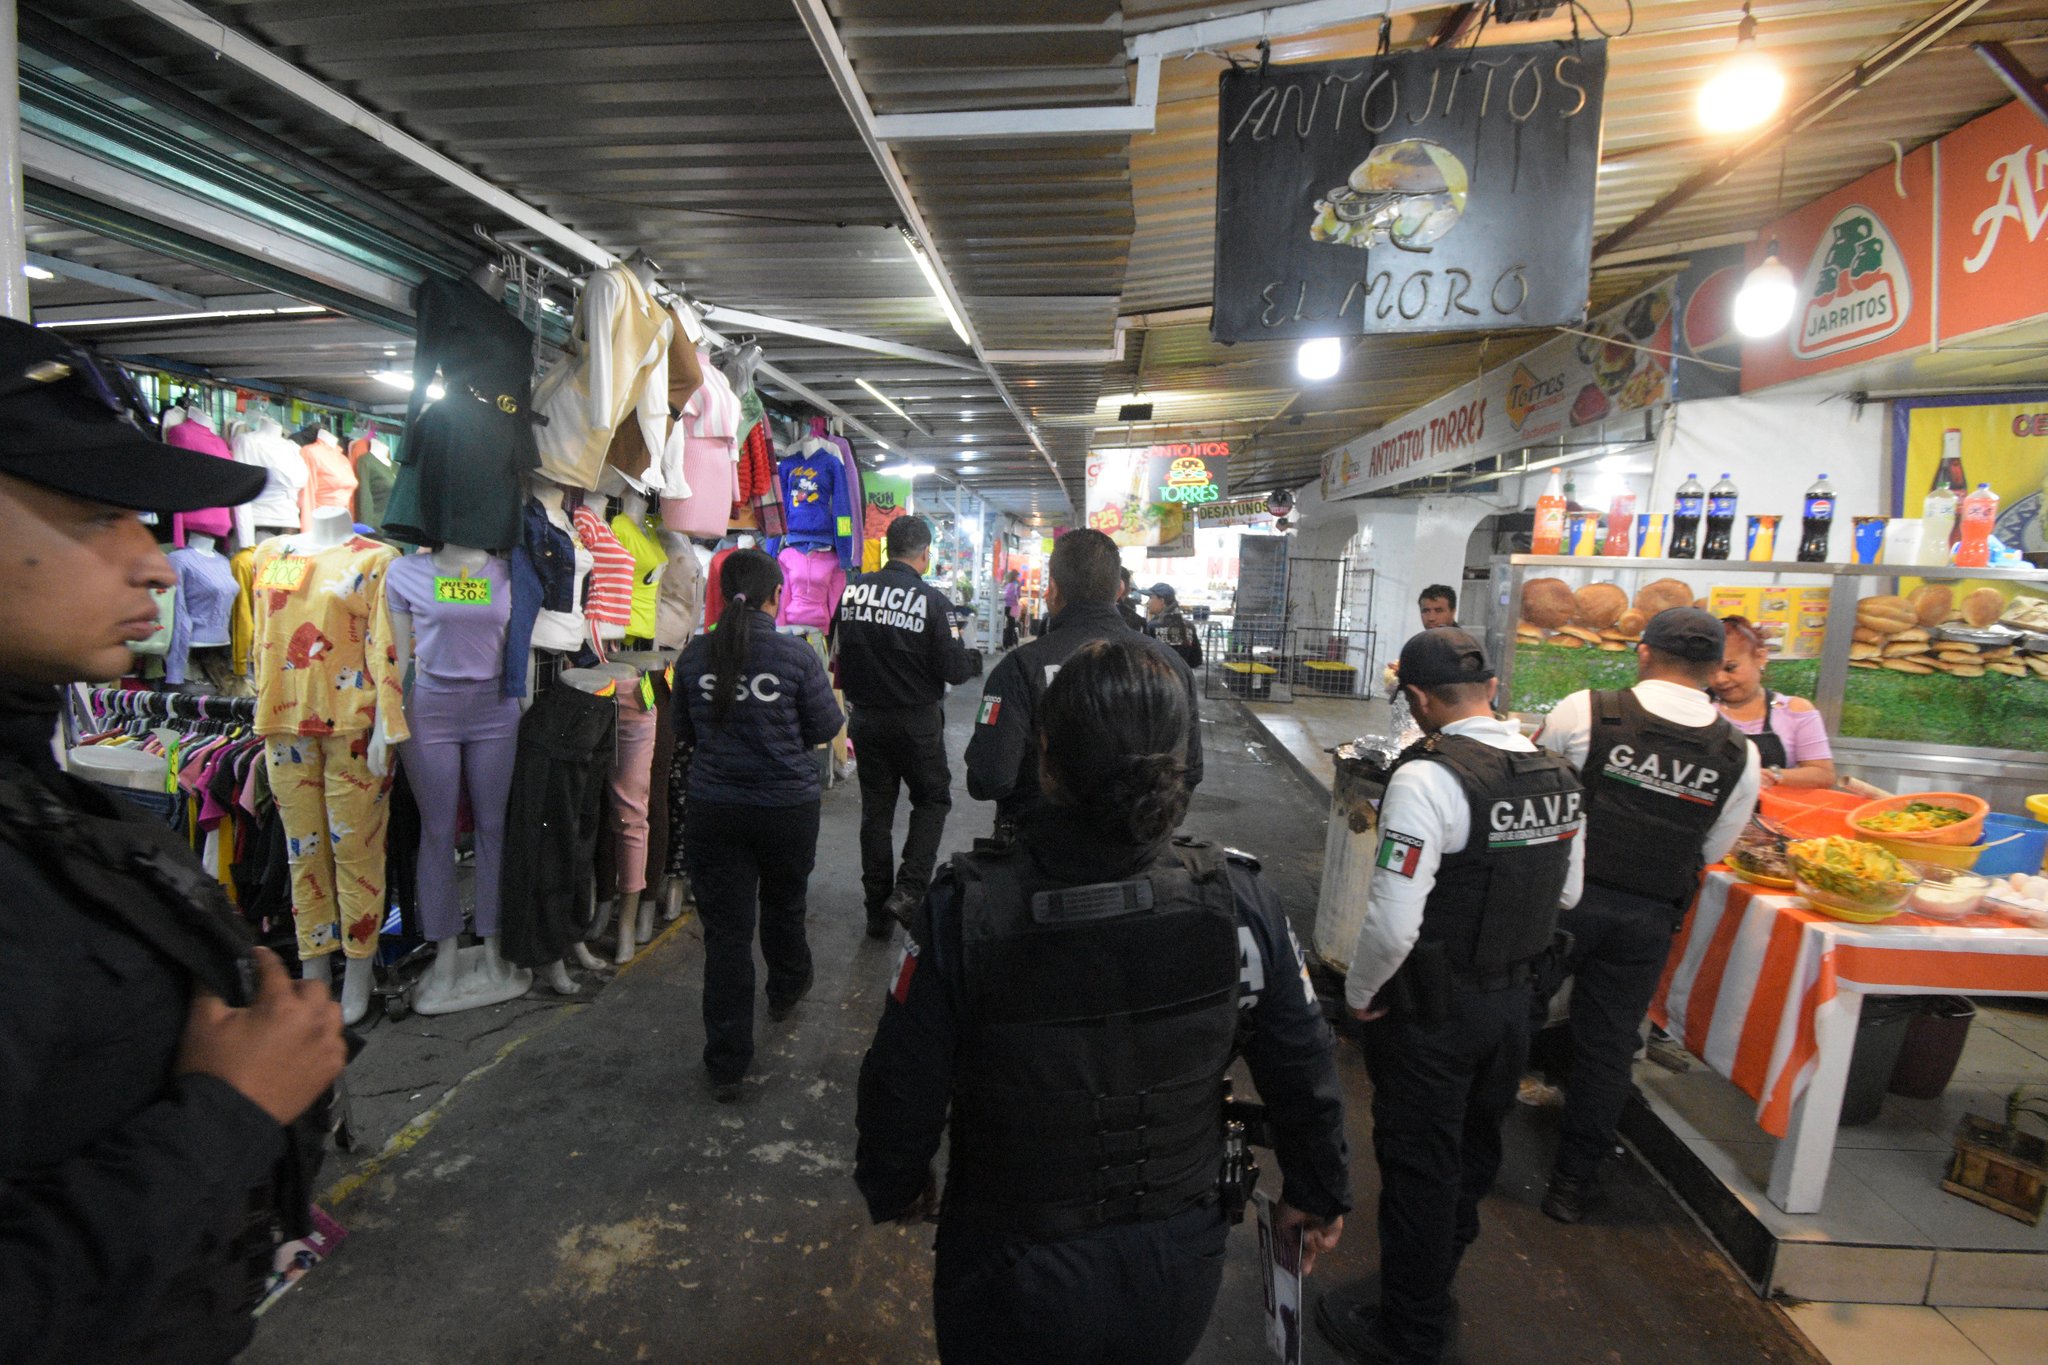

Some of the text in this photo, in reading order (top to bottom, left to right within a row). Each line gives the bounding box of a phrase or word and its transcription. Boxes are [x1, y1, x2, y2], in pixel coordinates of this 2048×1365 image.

[1227, 54, 1587, 144] ANTOJITOS
[1260, 263, 1528, 328] EL MORO
[1807, 294, 1888, 338] JARRITOS
[1149, 441, 1230, 458] ANTOJITOS
[1368, 397, 1487, 479] ANTOJITOS TORRES
[1157, 484, 1219, 504] TORRES
[1199, 500, 1269, 520] DESAYUNOS
[1089, 508, 1120, 530] $25
[841, 583, 928, 619] POLICÍA
[840, 606, 855, 622] DE
[855, 605, 873, 623] LA
[874, 608, 925, 634] CIUDAD
[1608, 743, 1721, 795] G.A.V.P.
